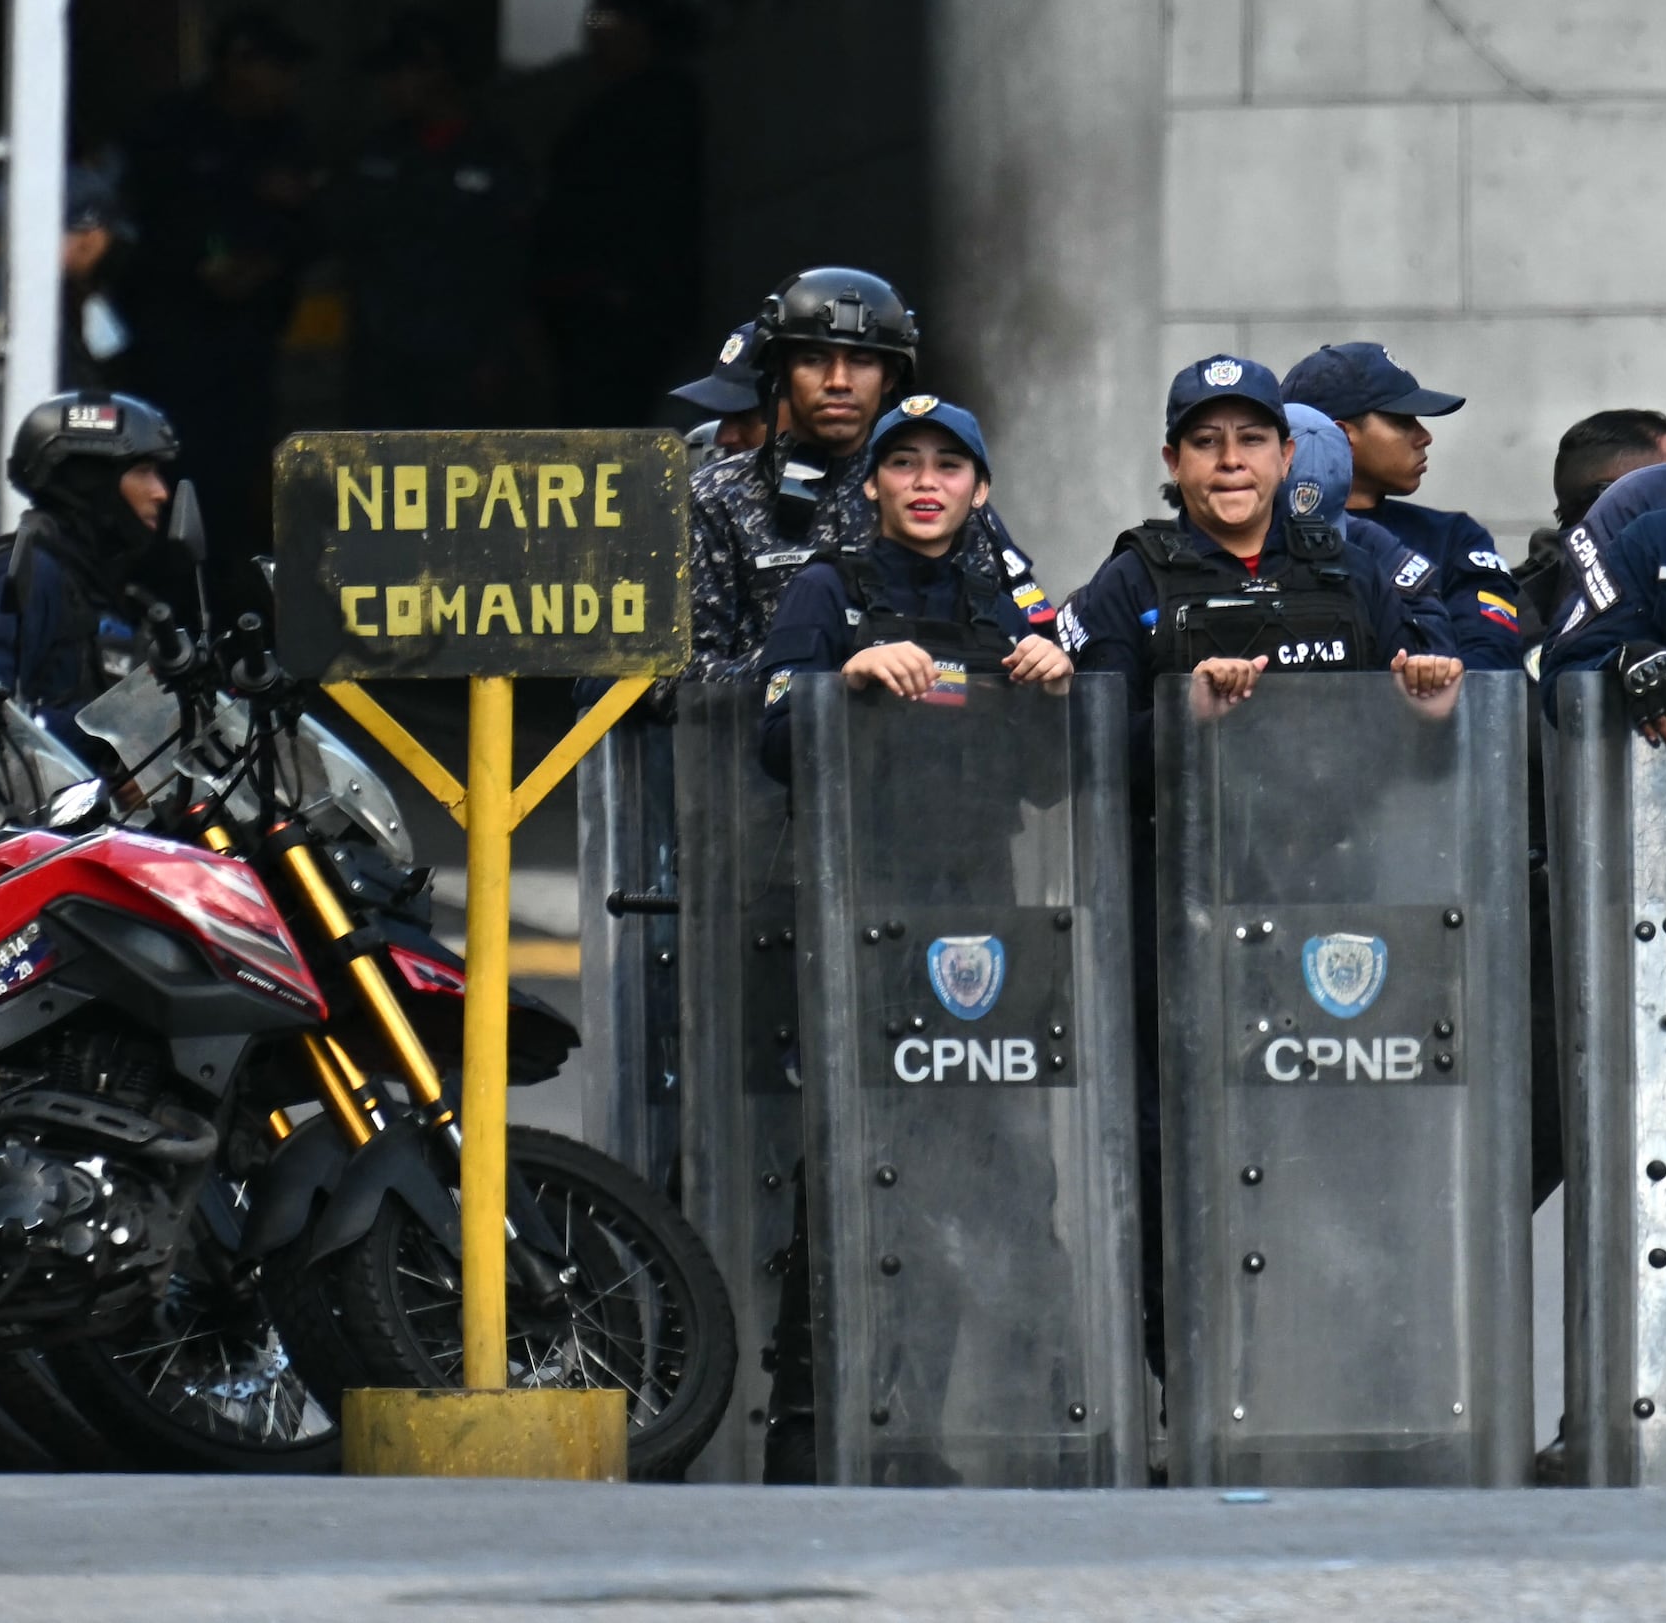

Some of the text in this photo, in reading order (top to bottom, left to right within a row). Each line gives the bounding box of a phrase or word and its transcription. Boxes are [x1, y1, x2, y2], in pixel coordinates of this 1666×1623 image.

[336, 463, 623, 531] NO PARE
[339, 583, 646, 637] COMANDO
[8, 936, 30, 958] 14
[14, 960, 34, 981] 20
[893, 1037, 1038, 1083] CPNB
[1264, 1036, 1422, 1082] CPNB
